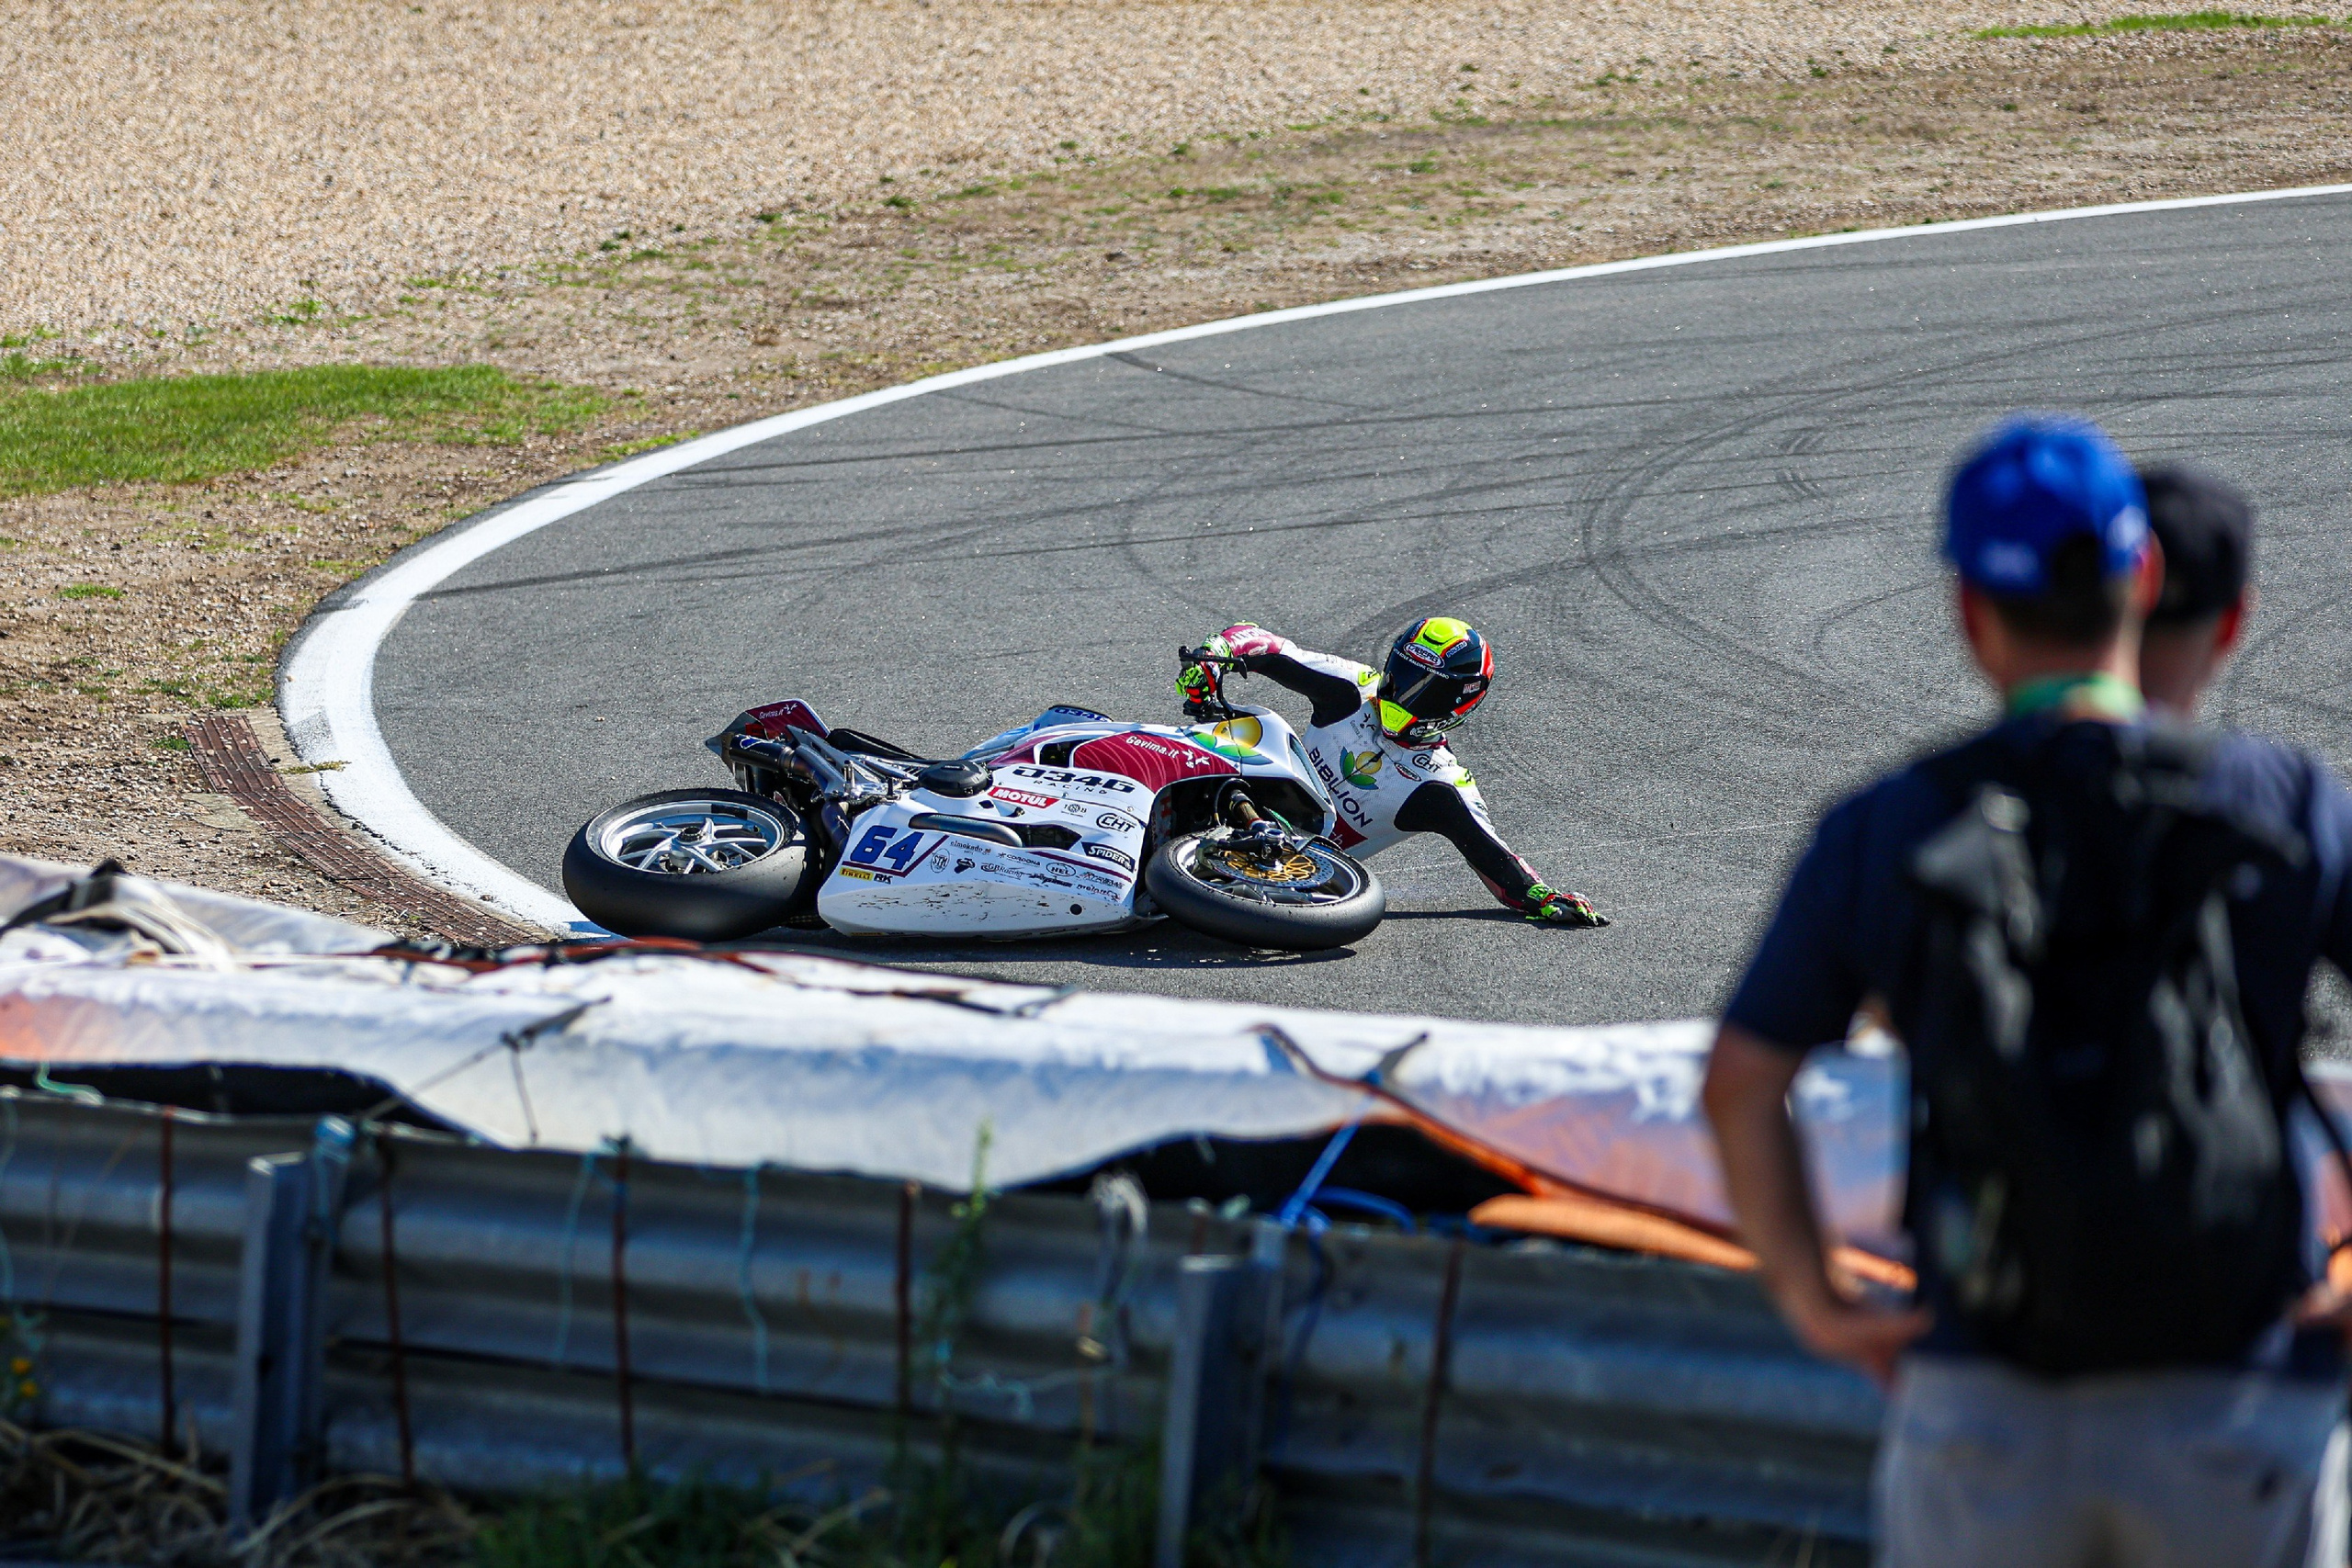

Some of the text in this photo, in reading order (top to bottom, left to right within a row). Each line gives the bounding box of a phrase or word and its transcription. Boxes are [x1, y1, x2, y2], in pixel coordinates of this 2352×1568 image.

[1125, 736, 1180, 759] Gevima.it
[1416, 755, 1442, 774] CHT
[1034, 780, 1108, 795] RACING
[1308, 747, 1374, 828] BIBLION
[993, 788, 1047, 807] MOTUL
[1102, 817, 1136, 833] CHT
[850, 825, 925, 871] 64
[1088, 845, 1127, 865] SPIDER
[933, 854, 948, 868] STM
[1007, 854, 1041, 866] CORDONA
[842, 868, 871, 880] PIRELLI
[988, 863, 1023, 879] GBRacing
[1051, 866, 1070, 875] HEL
[874, 874, 893, 885] RK
